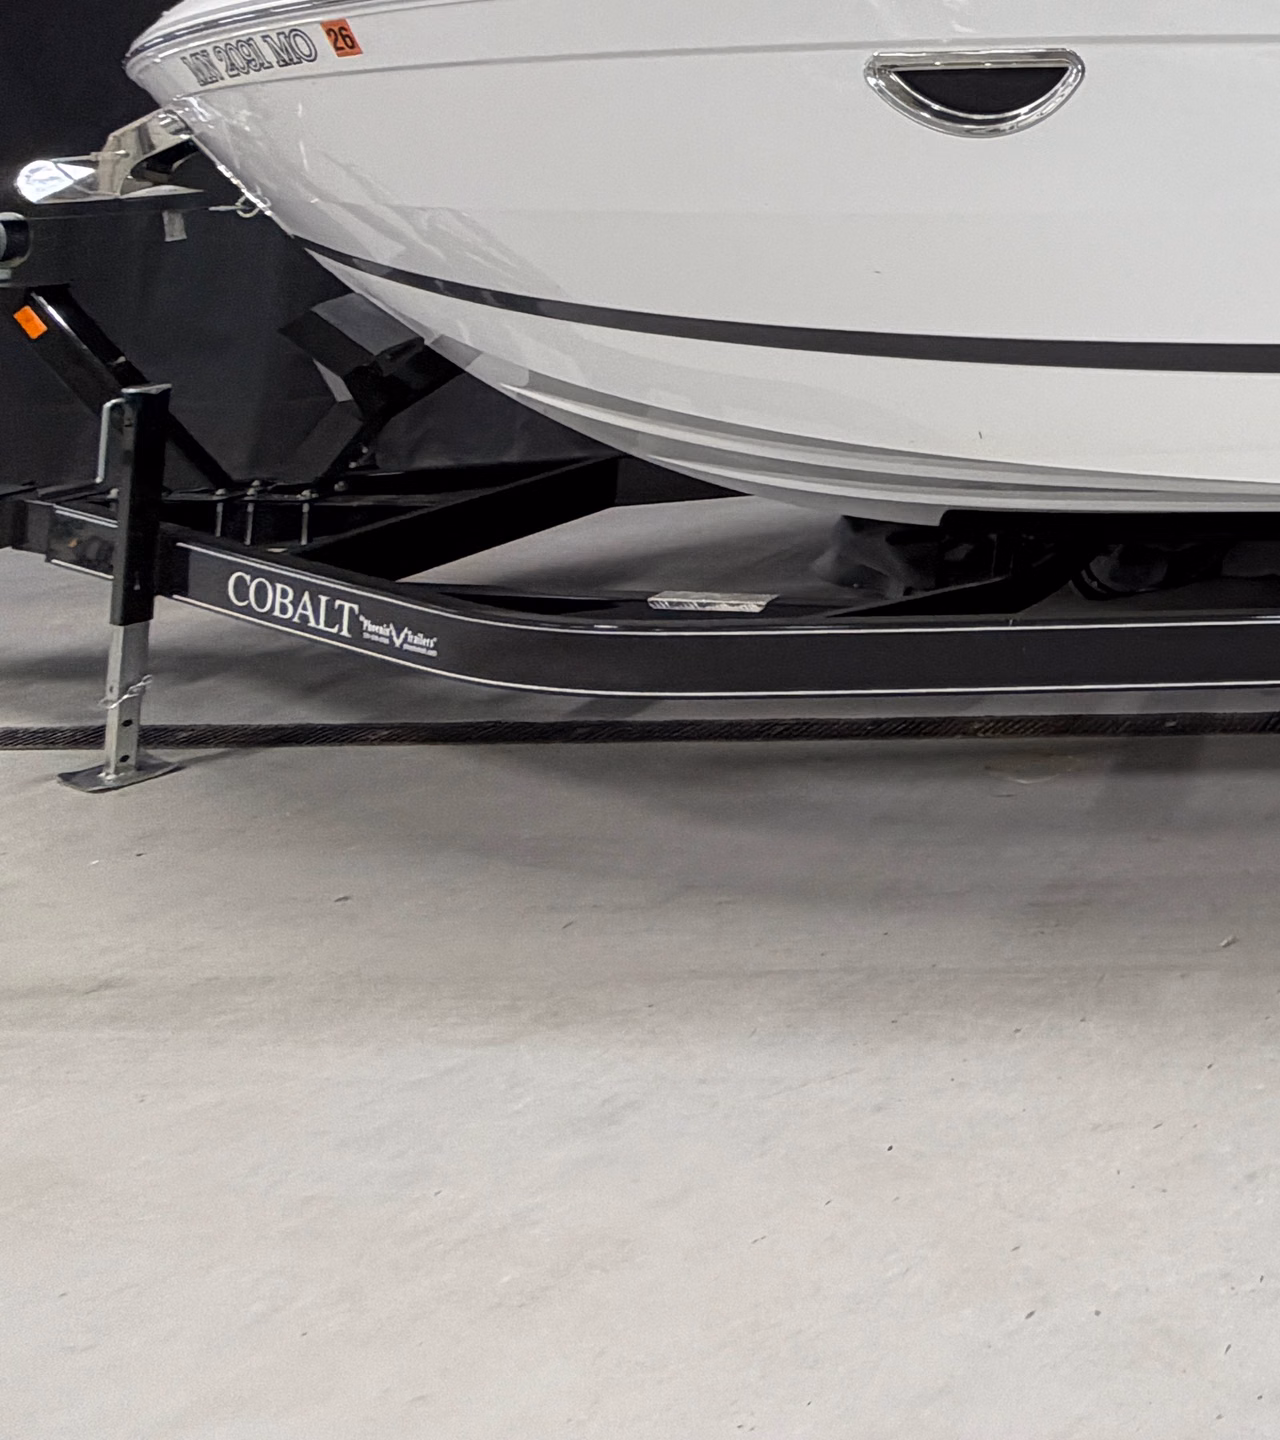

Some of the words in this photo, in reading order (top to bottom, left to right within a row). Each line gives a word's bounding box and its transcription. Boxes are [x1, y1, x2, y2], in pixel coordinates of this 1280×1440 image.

[213, 37, 275, 78] 2091
[260, 28, 318, 68] MO
[325, 26, 355, 51] 26
[227, 571, 359, 637] COBALT
